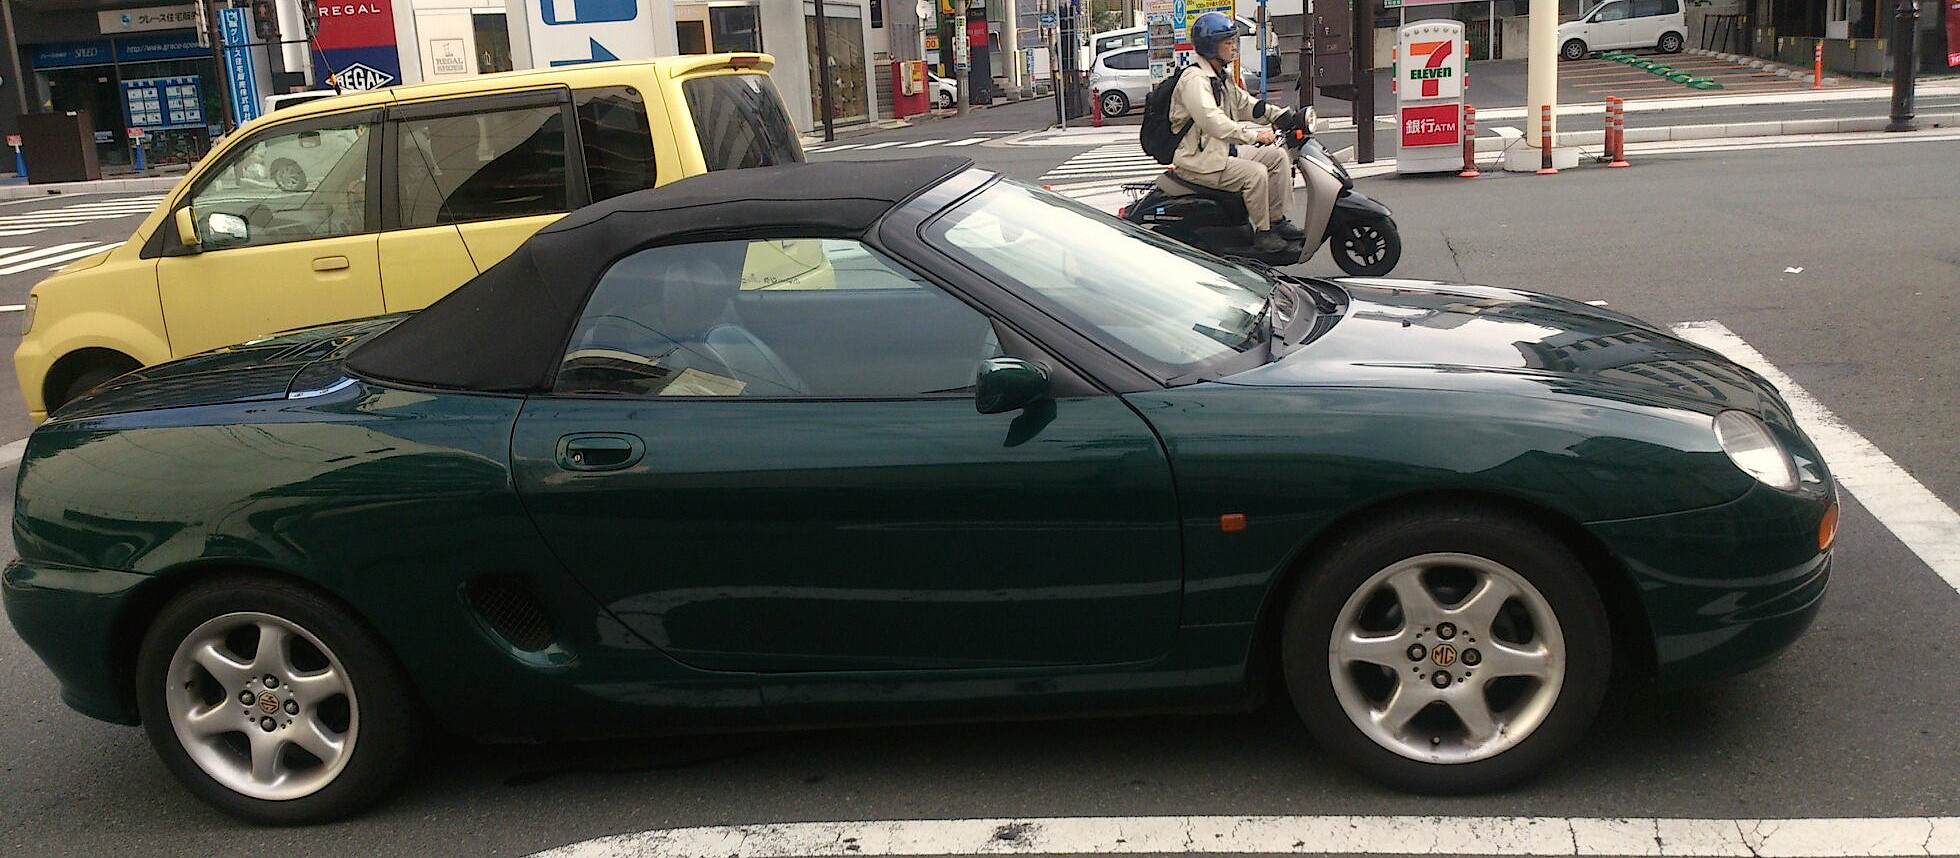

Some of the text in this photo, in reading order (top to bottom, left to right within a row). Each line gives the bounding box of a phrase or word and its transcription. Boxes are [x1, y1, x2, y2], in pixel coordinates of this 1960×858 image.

[319, 4, 380, 16] REGAL
[436, 57, 463, 65] REGAL
[1410, 40, 1452, 97] 7
[337, 67, 385, 90] REGAL
[1405, 118, 1456, 134] 銀行ATM
[1434, 646, 1455, 665] MG
[260, 694, 278, 712] MG
